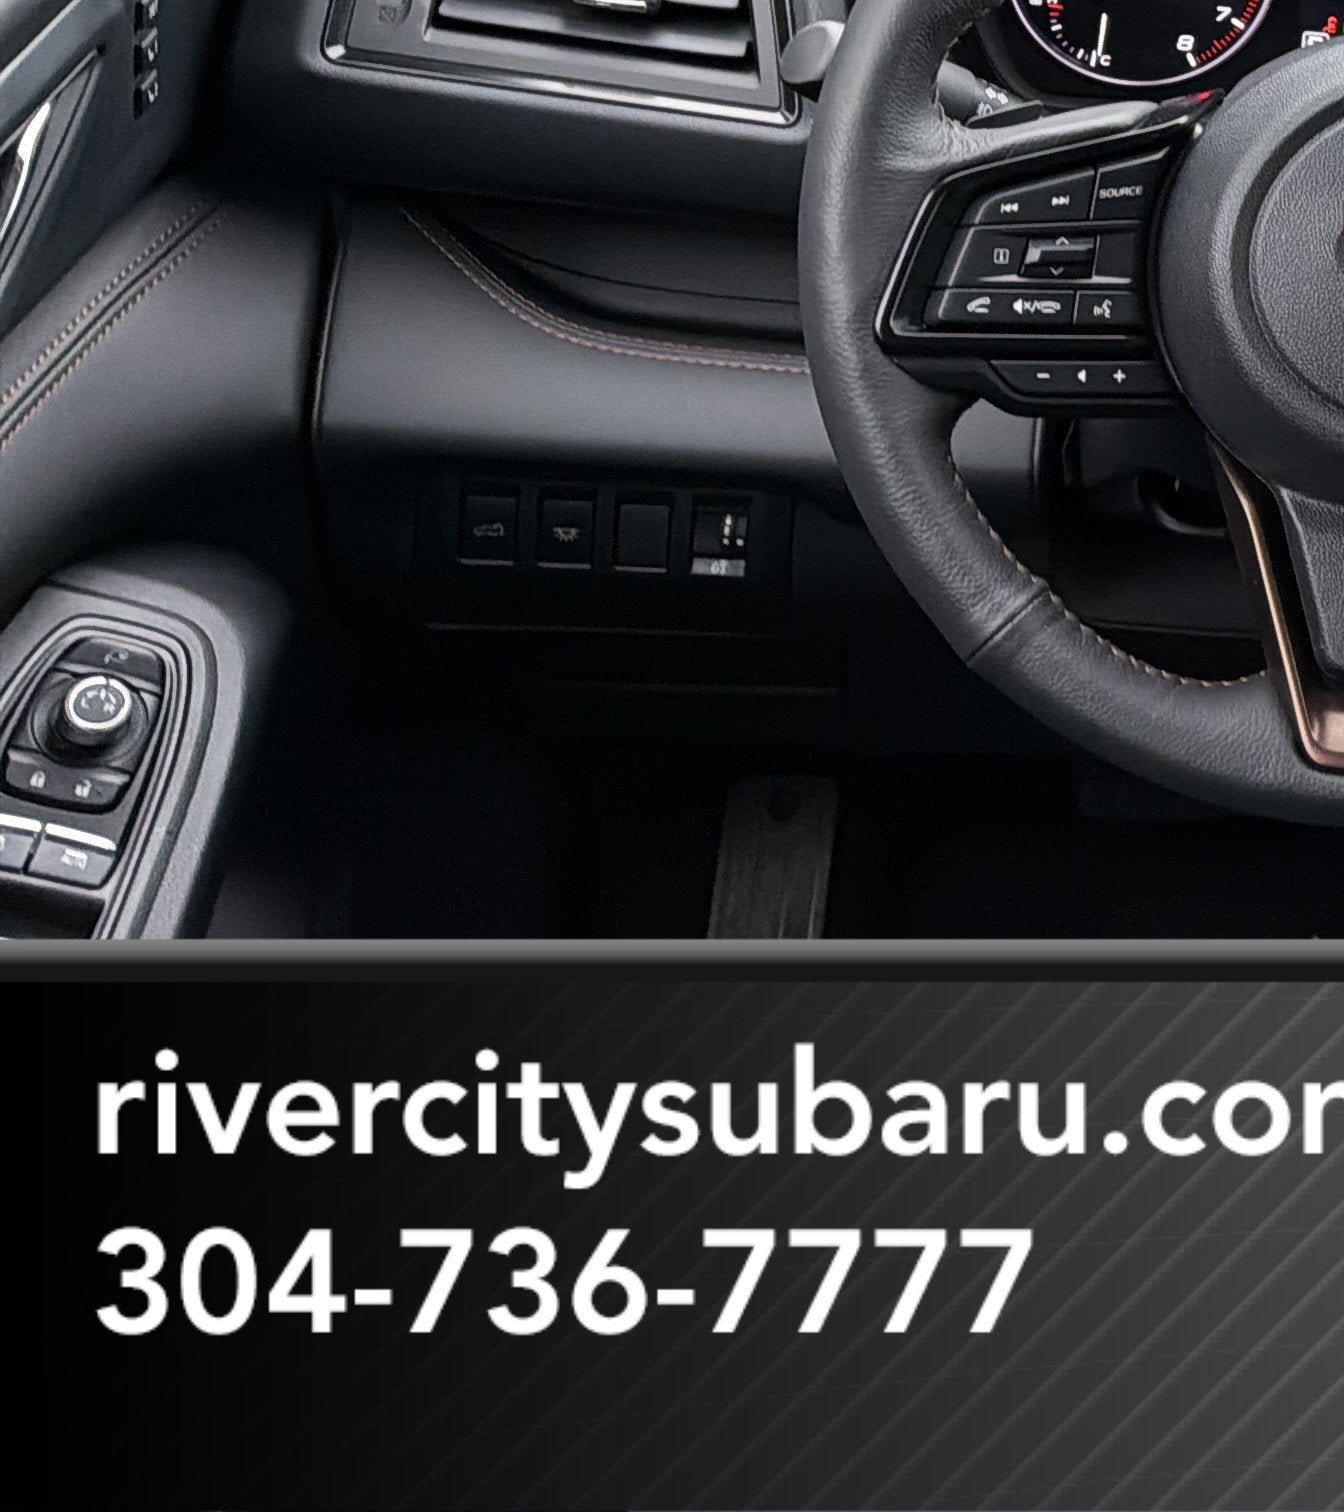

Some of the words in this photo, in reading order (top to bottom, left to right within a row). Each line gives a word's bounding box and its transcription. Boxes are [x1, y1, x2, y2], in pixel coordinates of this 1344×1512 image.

[1216, 5, 1232, 22] 7
[1176, 34, 1195, 52] 8
[1099, 185, 1144, 200] SOURCE
